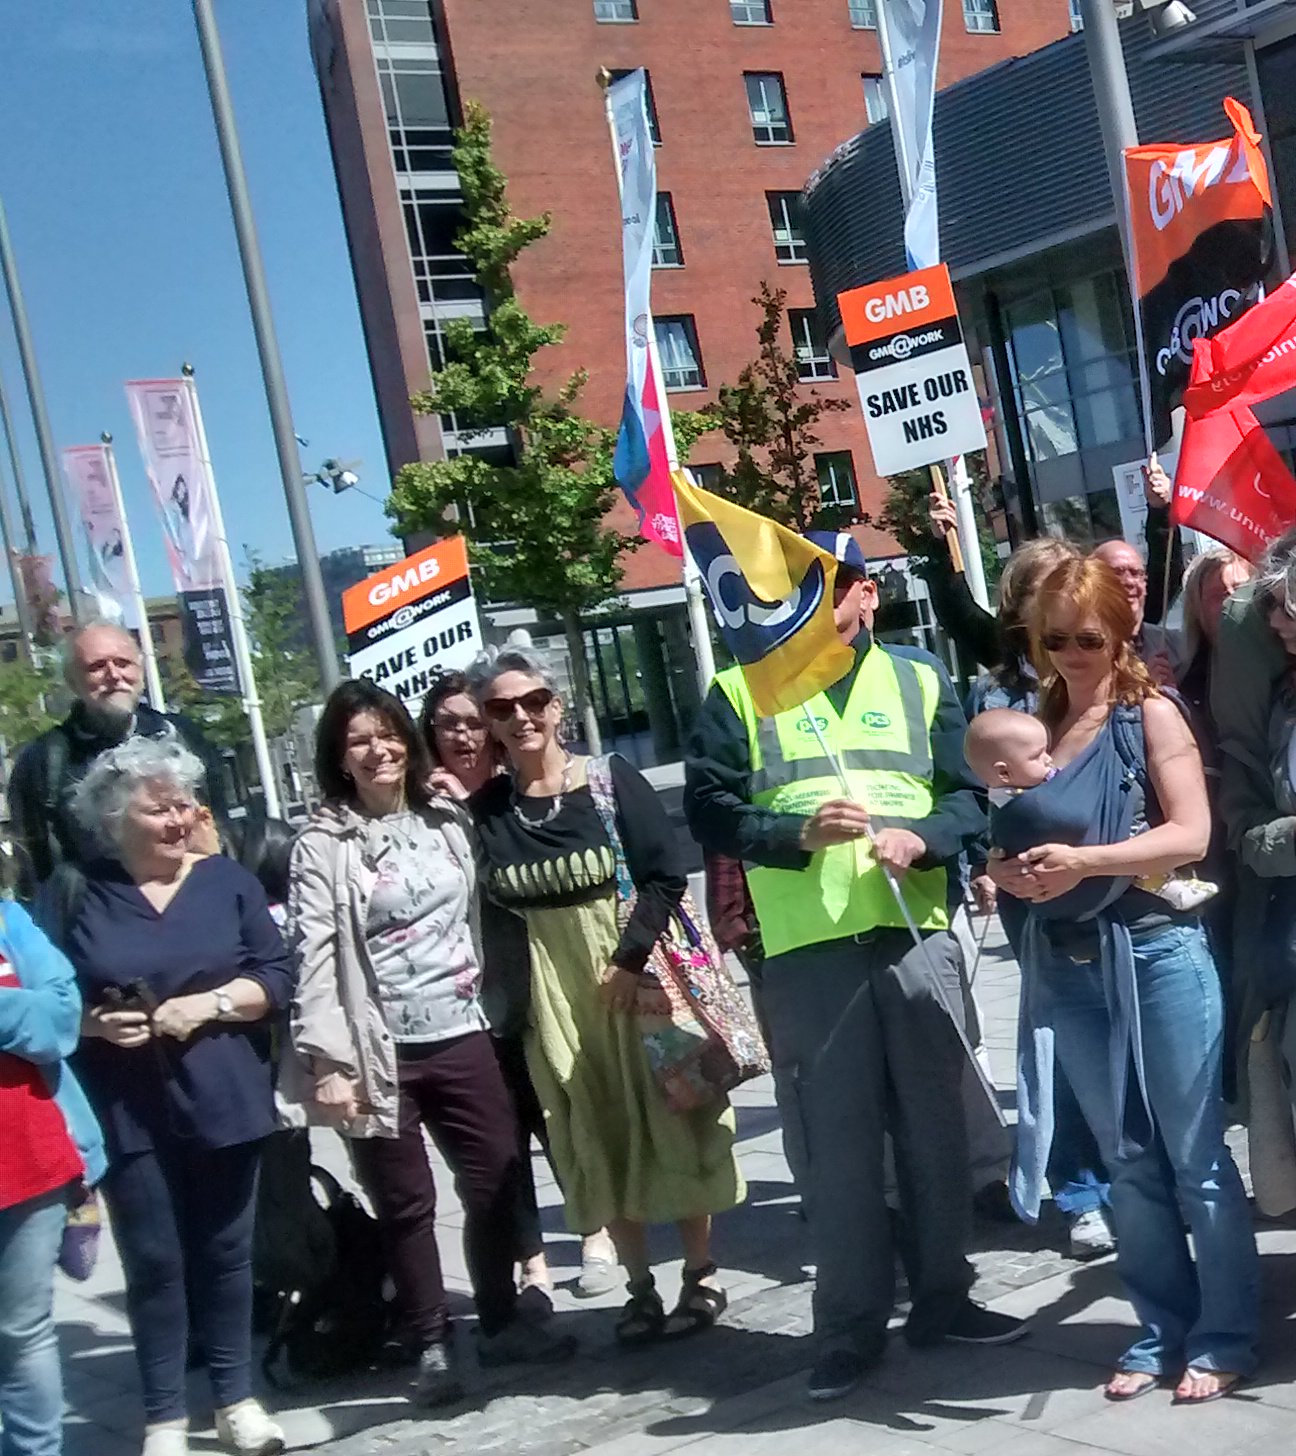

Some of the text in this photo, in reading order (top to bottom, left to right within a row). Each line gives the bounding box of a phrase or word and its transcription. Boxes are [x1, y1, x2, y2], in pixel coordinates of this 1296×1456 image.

[865, 285, 930, 323] GMB
[869, 329, 944, 360] GMB@WORK
[867, 369, 969, 418] SAVE OUR
[902, 411, 948, 444] NHS
[368, 558, 440, 606] GMB
[423, 620, 473, 658] OUR
[395, 664, 442, 699] NHS
